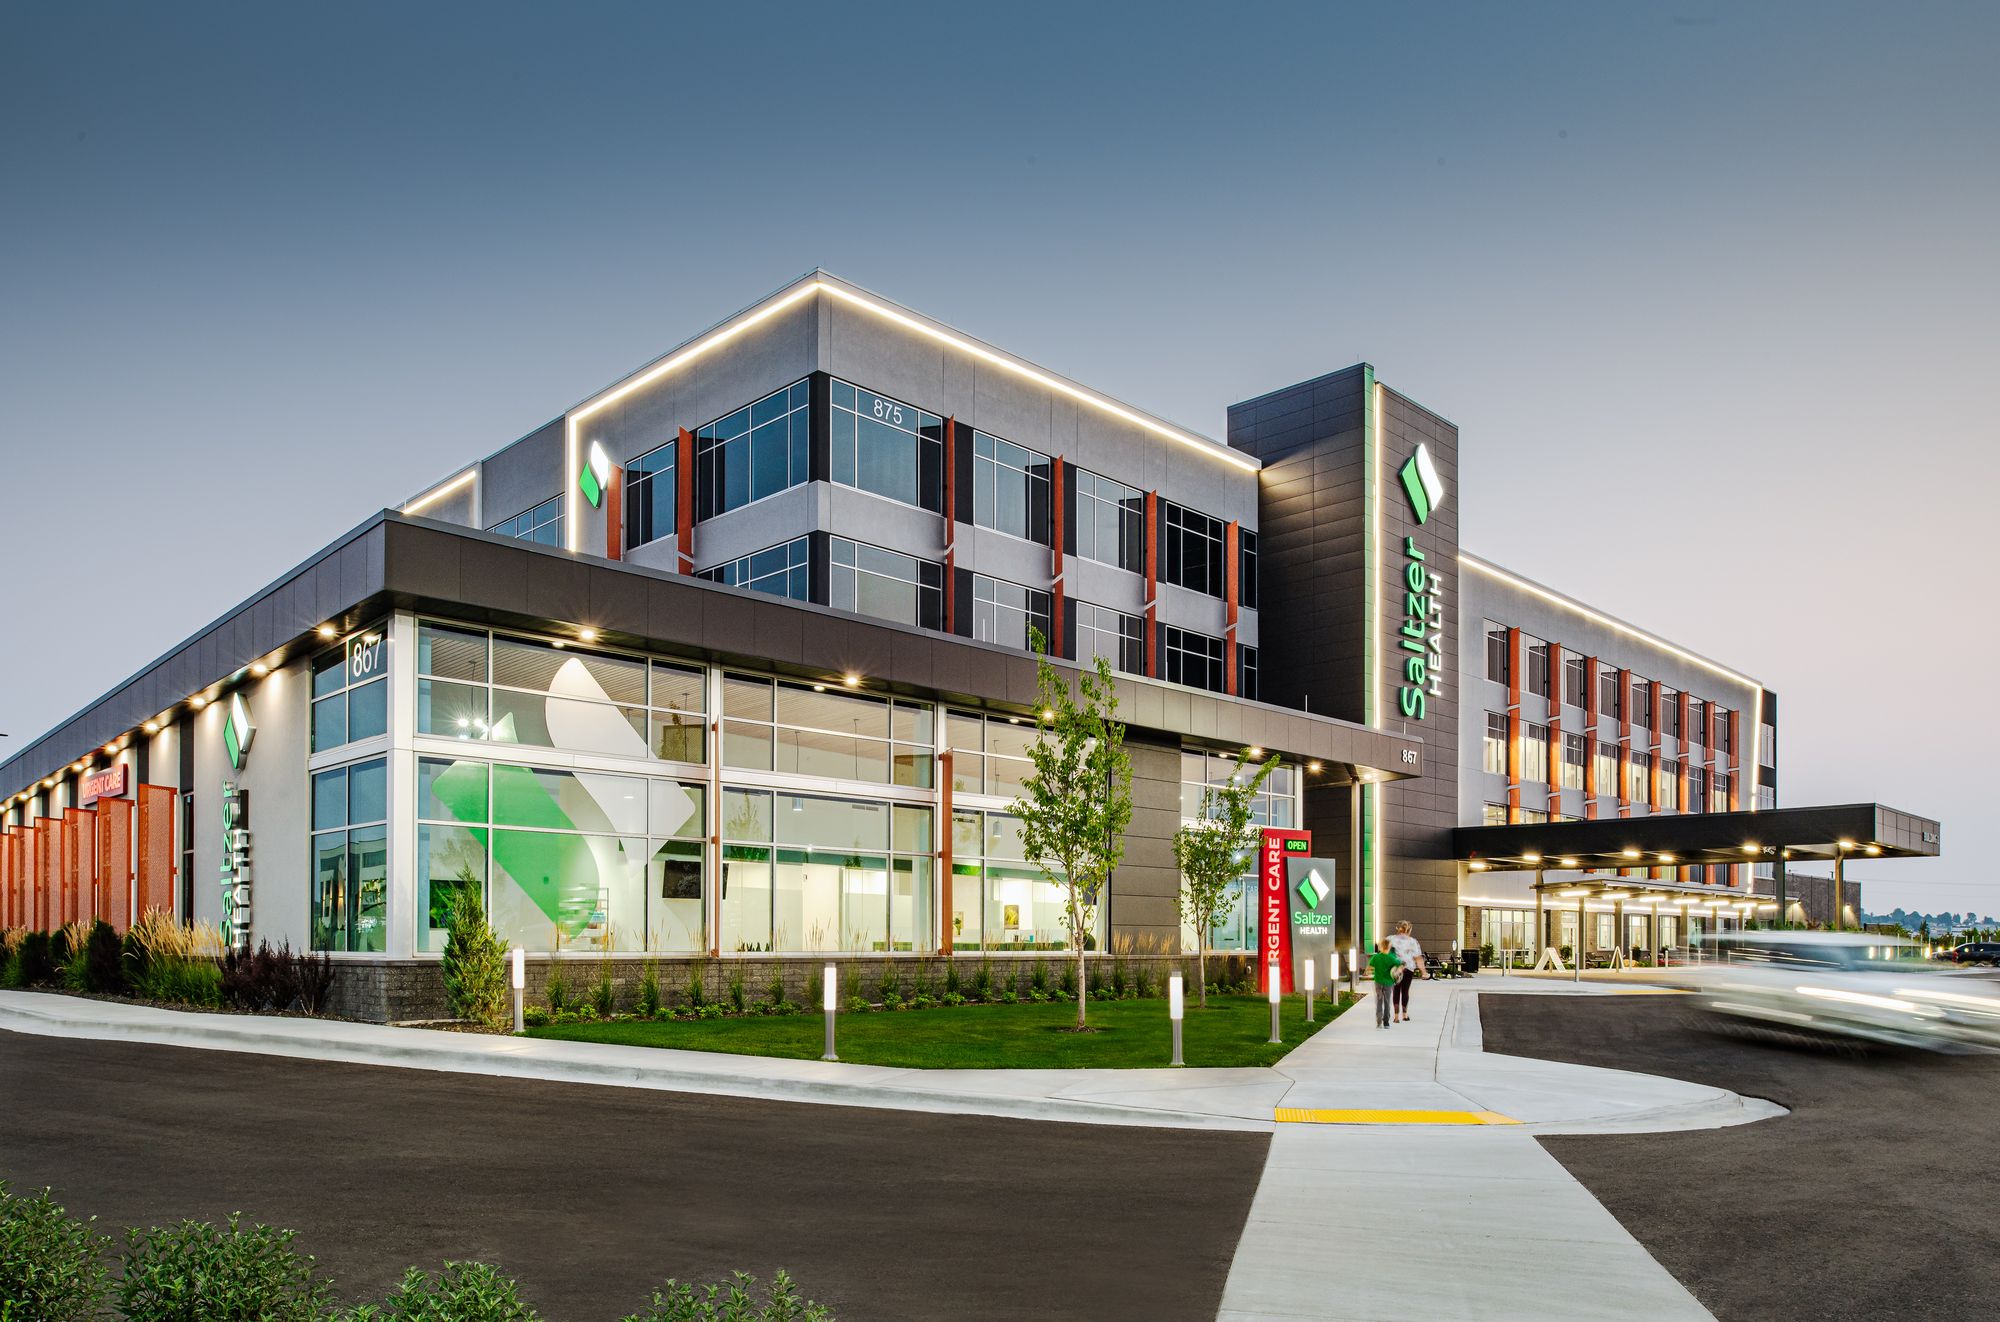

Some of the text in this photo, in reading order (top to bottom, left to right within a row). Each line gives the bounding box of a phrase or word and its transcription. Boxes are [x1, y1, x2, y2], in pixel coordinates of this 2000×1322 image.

[873, 399, 902, 424] 875
[1401, 536, 1425, 720] Saltzer
[1428, 573, 1442, 696] HEALTH
[353, 633, 382, 677] 867
[1402, 749, 1417, 764] 867
[82, 771, 121, 799] URGENT CARE
[219, 780, 233, 947] Saltzer
[1287, 840, 1307, 851] OPEN
[232, 829, 245, 948] HEALTH
[1268, 838, 1280, 965] RGENT CARE
[1294, 911, 1332, 925] Saltzer
[1300, 926, 1328, 935] HEALTH
